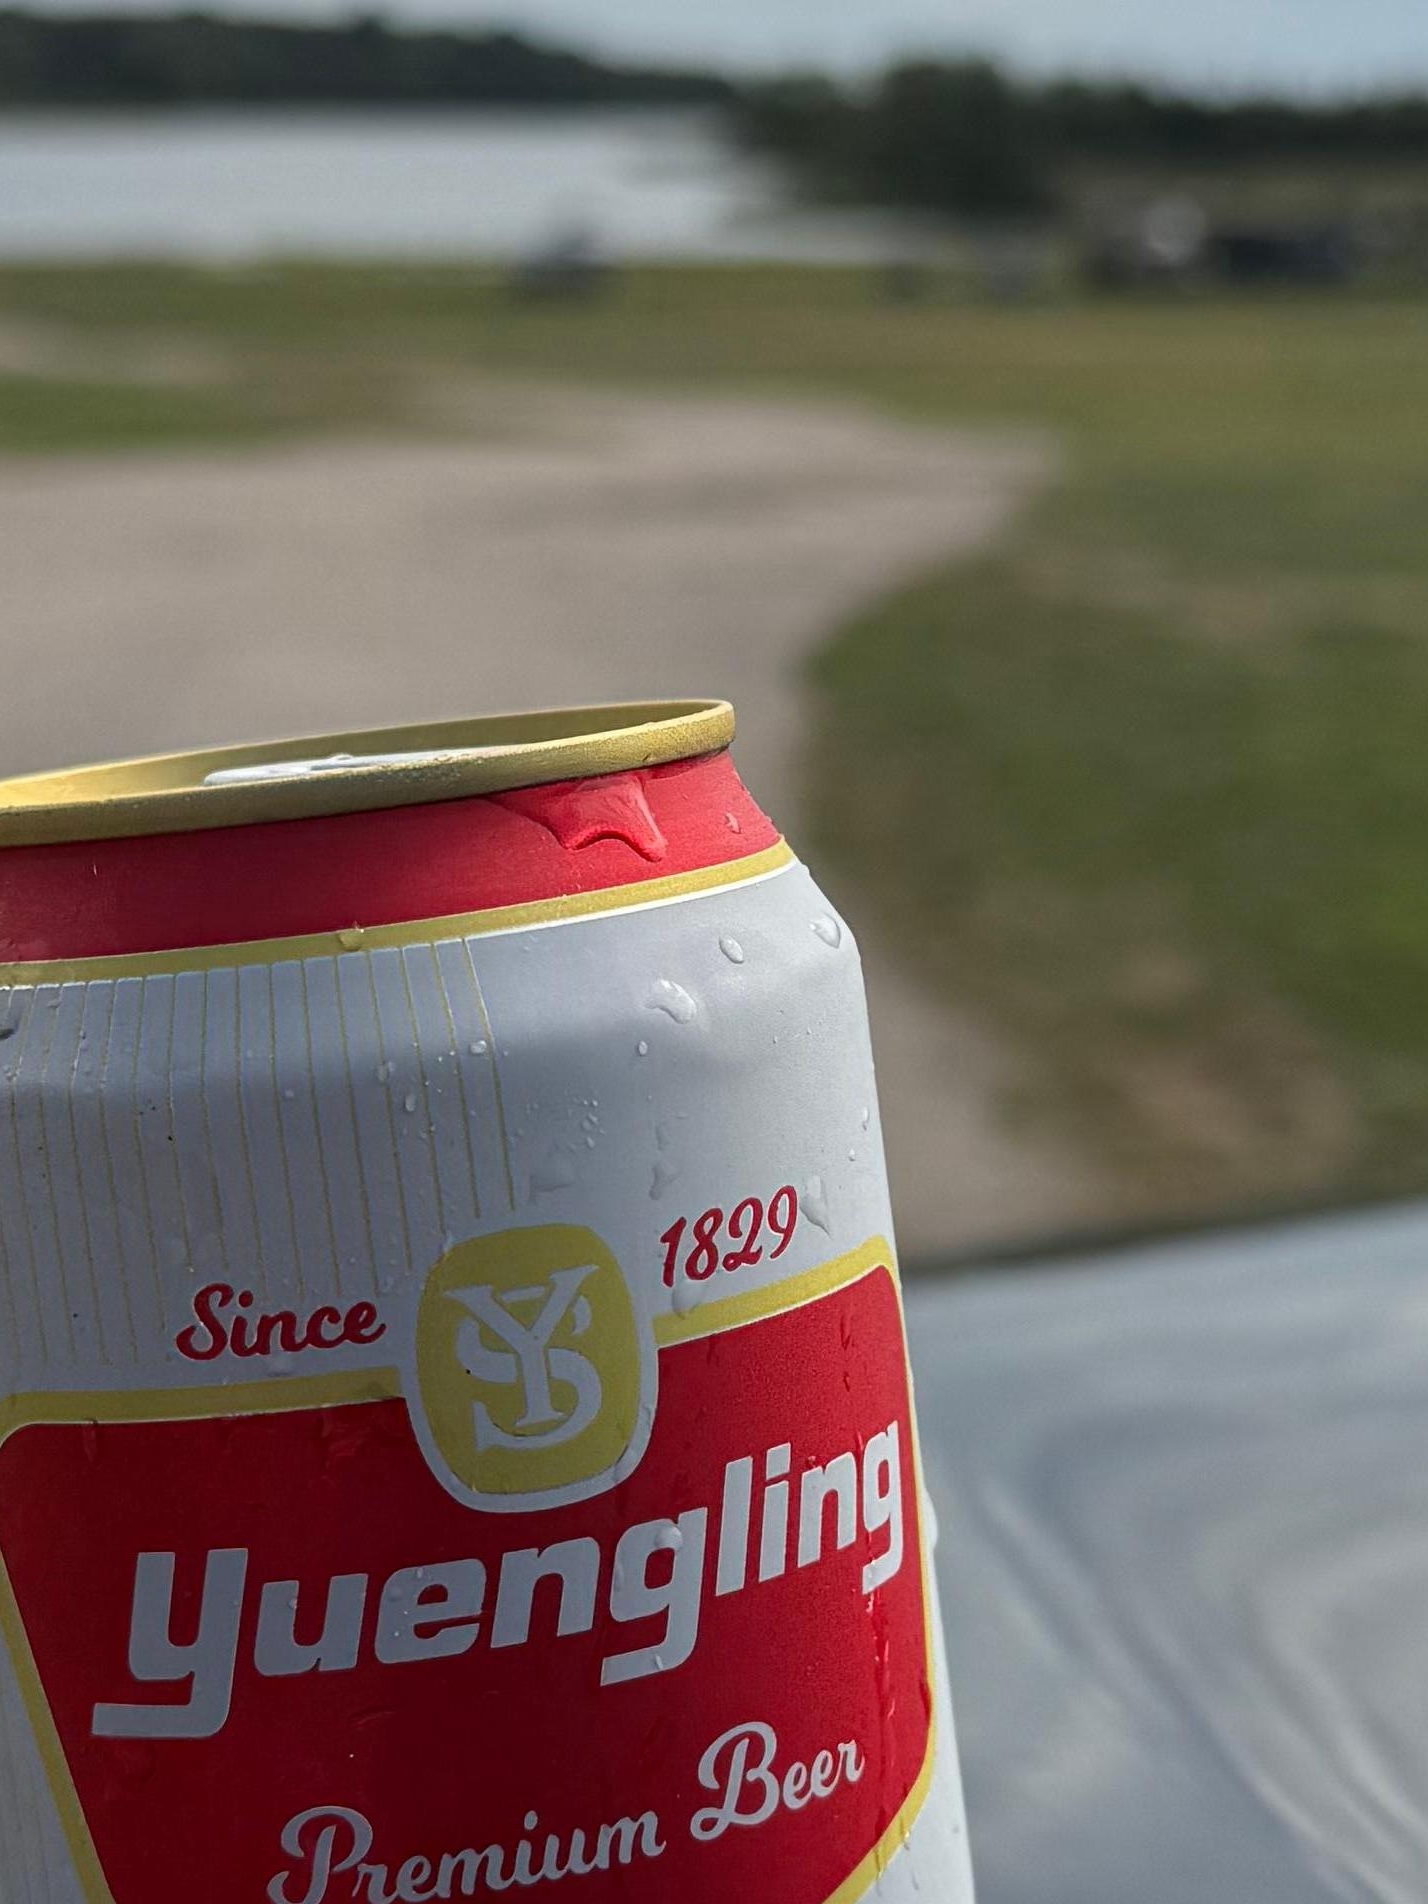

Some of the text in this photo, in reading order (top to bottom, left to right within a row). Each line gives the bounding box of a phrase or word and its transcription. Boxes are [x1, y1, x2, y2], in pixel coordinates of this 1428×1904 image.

[658, 1184, 800, 1289] 1829
[174, 1282, 389, 1363] Since
[89, 1417, 902, 1741] Yuengling
[689, 1718, 866, 1841] Beer
